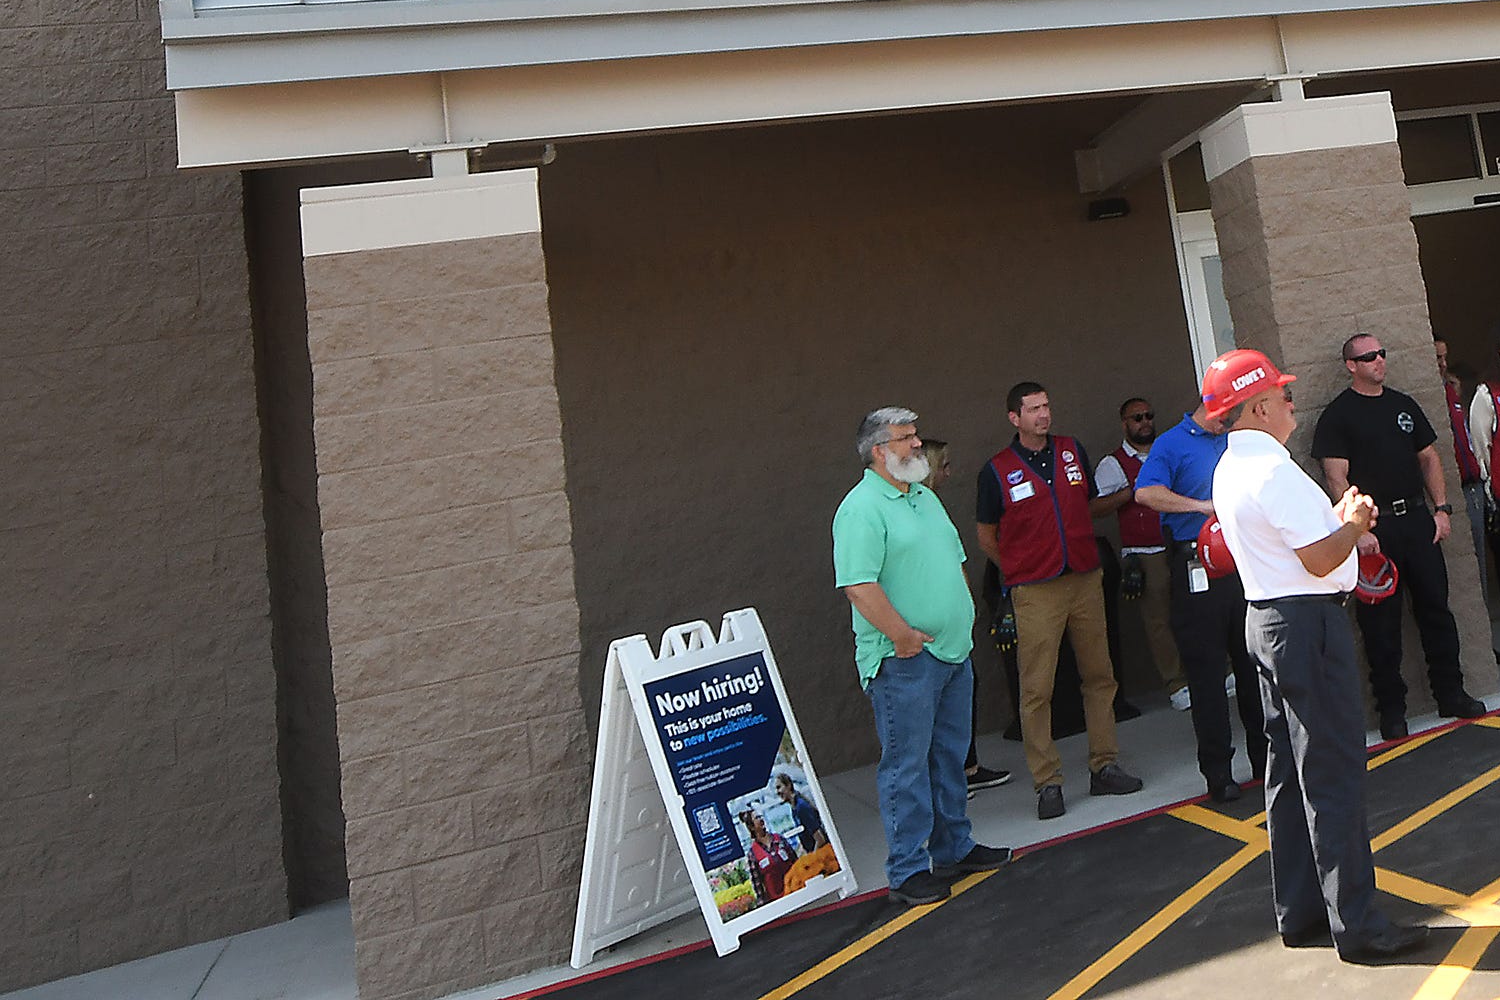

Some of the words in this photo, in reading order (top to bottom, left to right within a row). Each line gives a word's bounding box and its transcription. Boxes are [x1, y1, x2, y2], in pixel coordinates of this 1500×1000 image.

[655, 690, 700, 717] Now
[701, 666, 764, 703] hiring!
[663, 720, 689, 737] This
[687, 717, 699, 730] is
[699, 711, 722, 729] your
[722, 702, 752, 719] home
[669, 740, 683, 752] to
[683, 733, 705, 748] new
